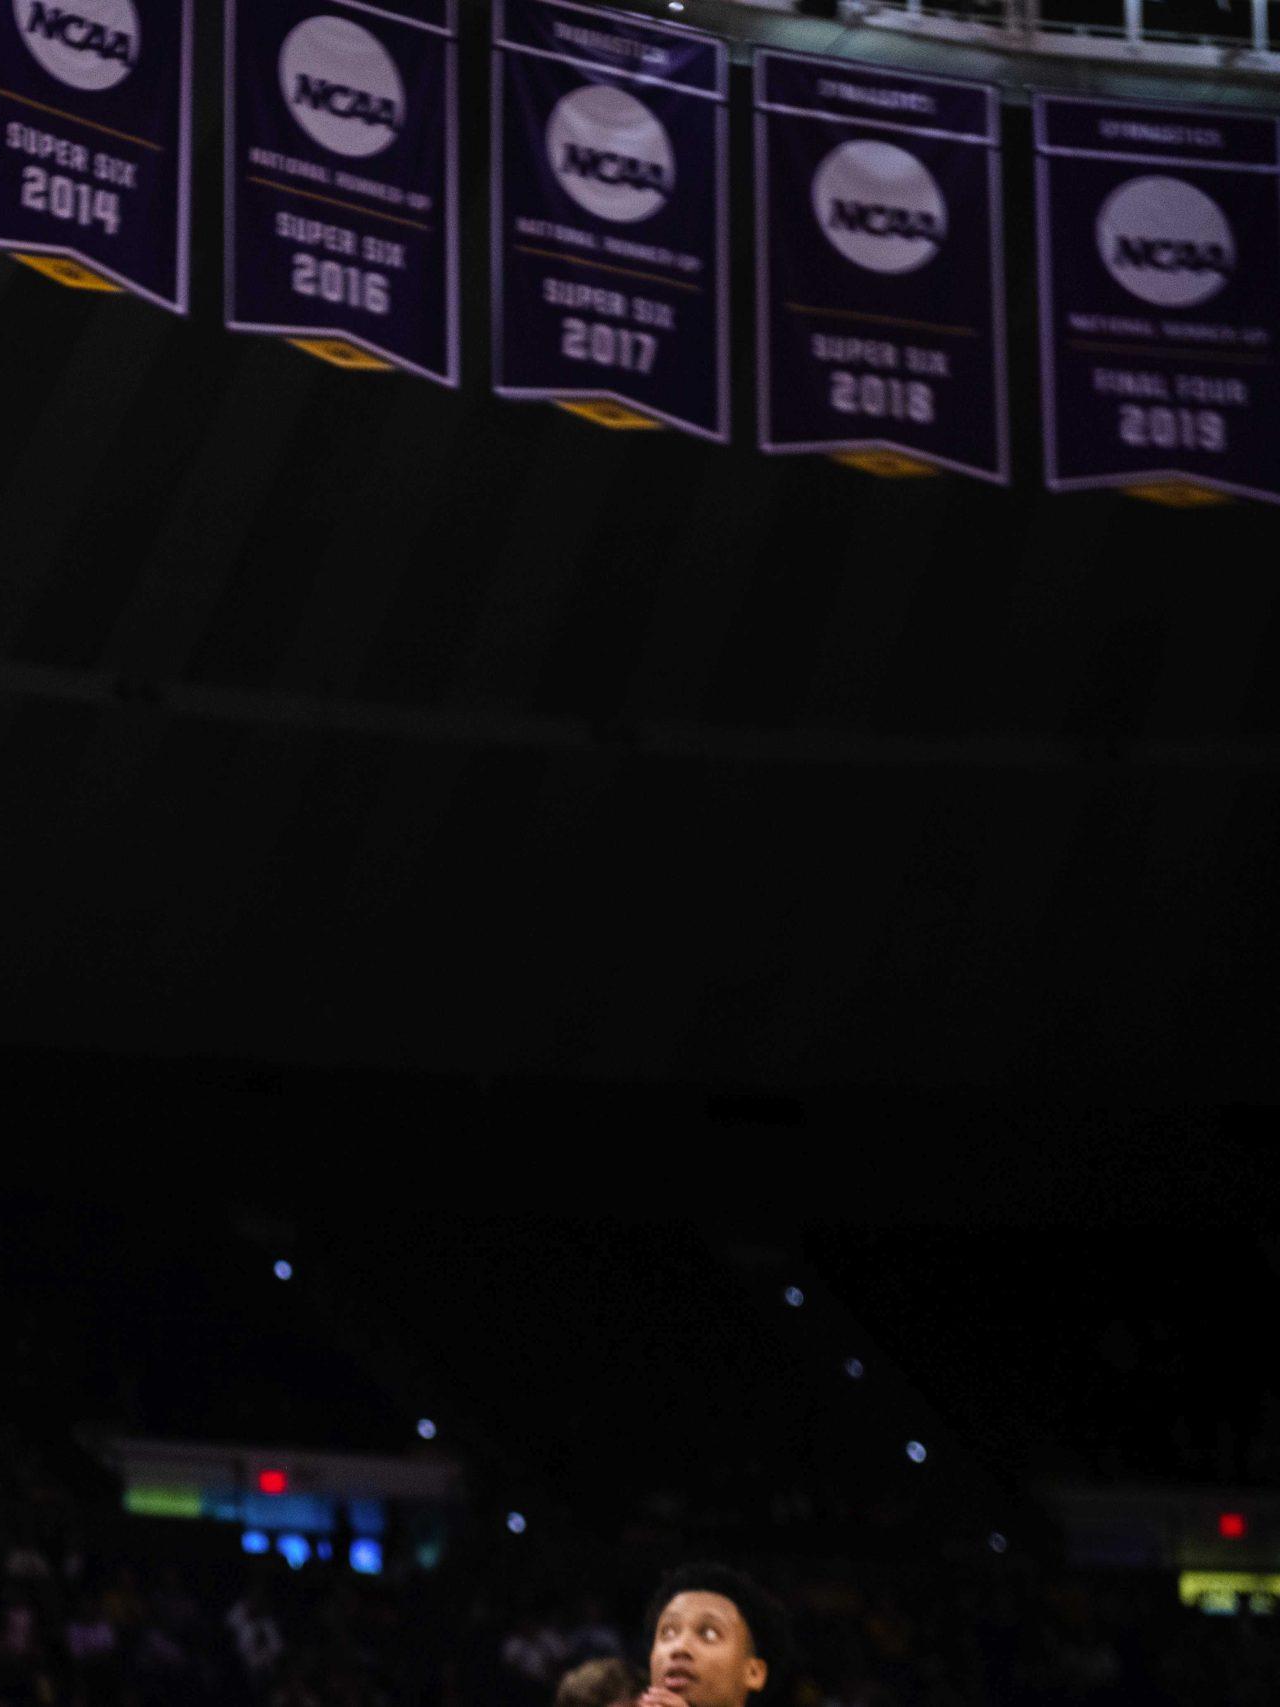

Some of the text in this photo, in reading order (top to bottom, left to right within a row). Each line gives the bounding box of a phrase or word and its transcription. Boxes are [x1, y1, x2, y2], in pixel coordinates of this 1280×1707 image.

[28, 0, 136, 68] NCAA
[294, 72, 404, 134] NCAA
[6, 121, 137, 189] SUPER SIX
[563, 141, 674, 197] NCAA
[20, 166, 121, 235] 2014
[830, 199, 945, 243] NCAA
[275, 211, 407, 269] SUPER SIX
[1116, 235, 1234, 280] NCAA
[292, 252, 390, 315] 2016
[543, 277, 677, 330] SUPER SIX
[561, 317, 658, 375] 2017
